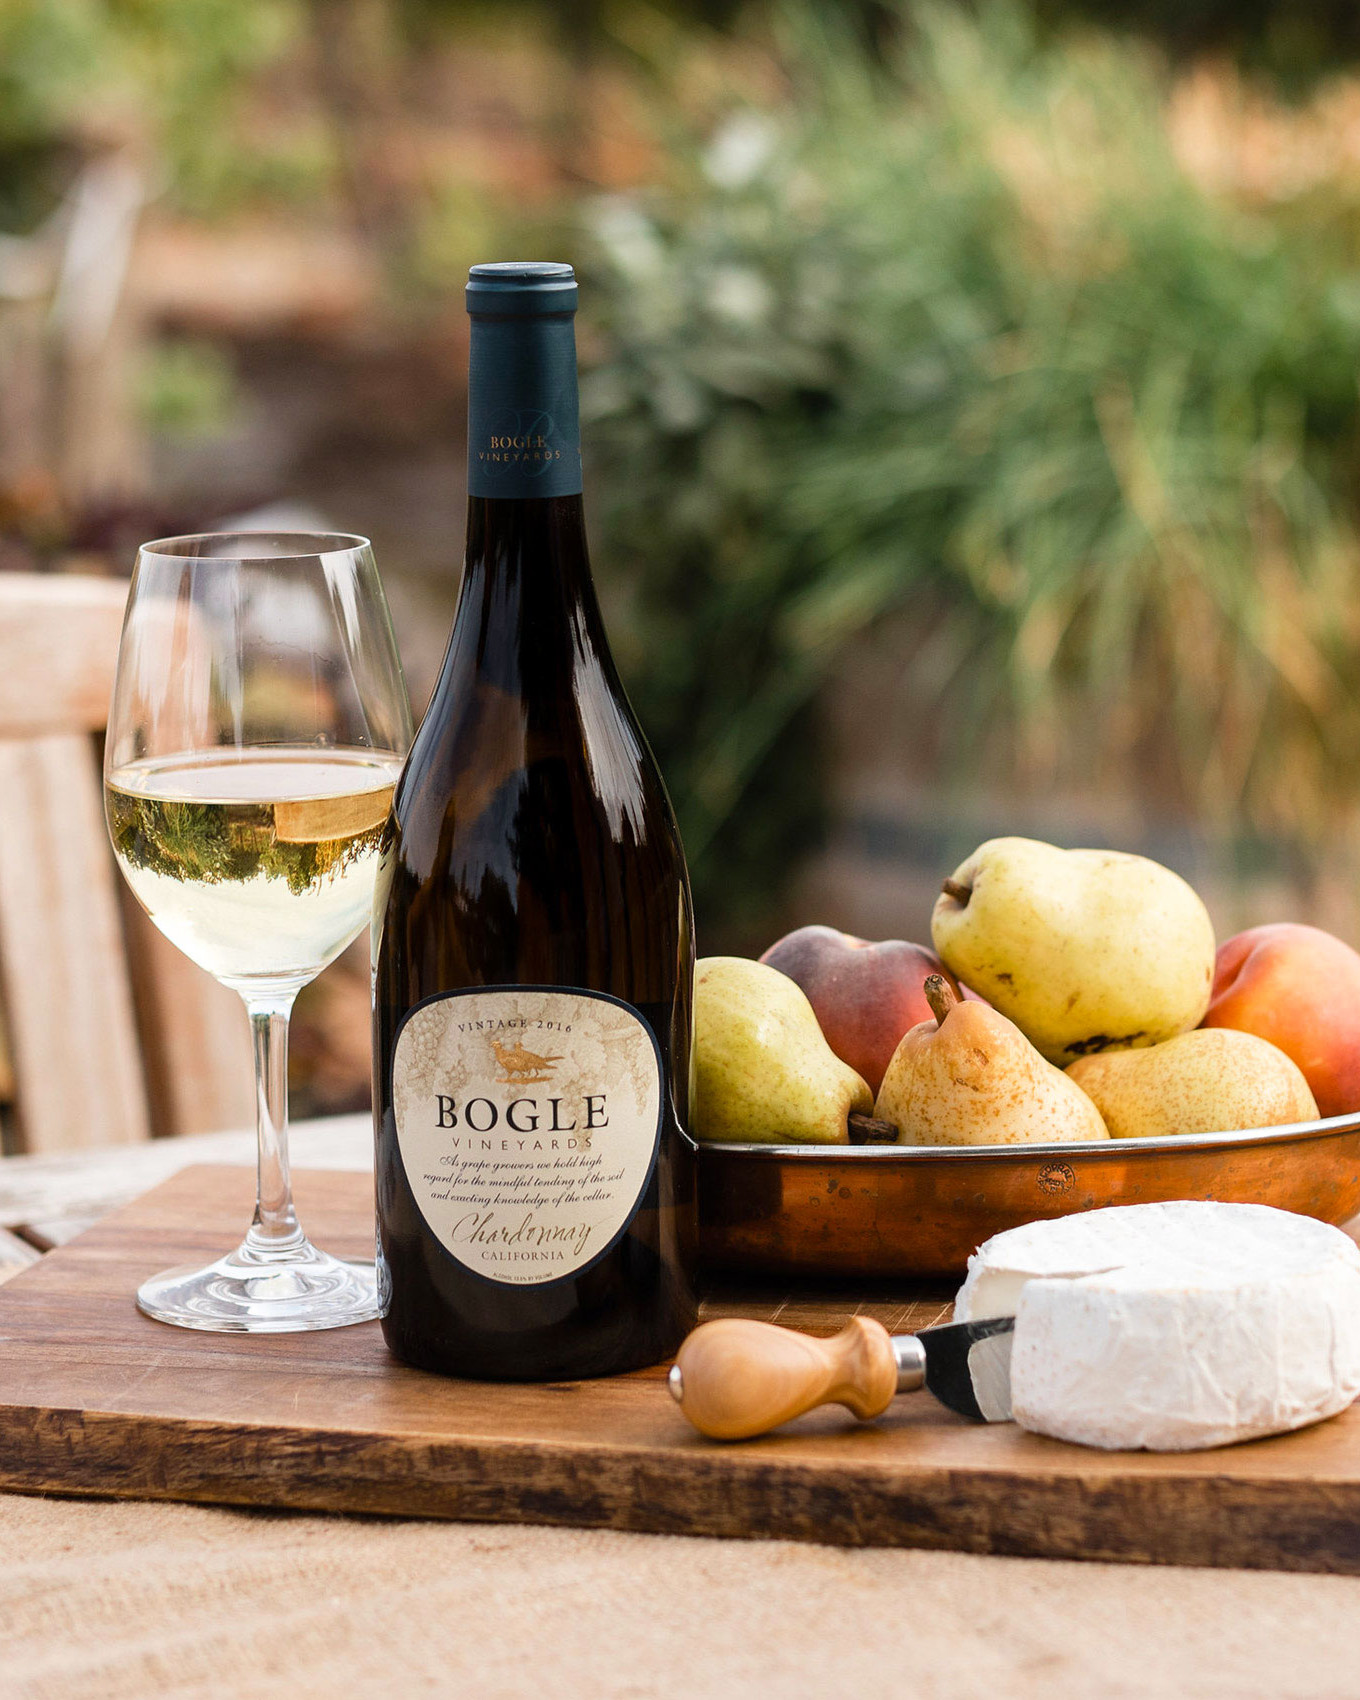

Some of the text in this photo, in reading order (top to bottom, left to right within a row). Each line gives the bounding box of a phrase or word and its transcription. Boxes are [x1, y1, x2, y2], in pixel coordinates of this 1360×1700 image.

[491, 435, 546, 449] BOGLE
[479, 450, 561, 462] VINEYARDS
[458, 1019, 572, 1033] VINTAGE 2016
[434, 1094, 610, 1133] BOGLE
[452, 1137, 592, 1151] VINEYARDS
[440, 1153, 602, 1174] As grape growers we hold high
[423, 1167, 626, 1192] regard for the mindful tending of the soil
[430, 1189, 451, 1200] and
[450, 1194, 491, 1208] exacting
[493, 1193, 550, 1209] knowledge
[551, 1191, 566, 1208] of
[564, 1191, 581, 1203] the
[451, 1211, 594, 1256] Chardonnay
[481, 1250, 565, 1261] CALIFORNIA
